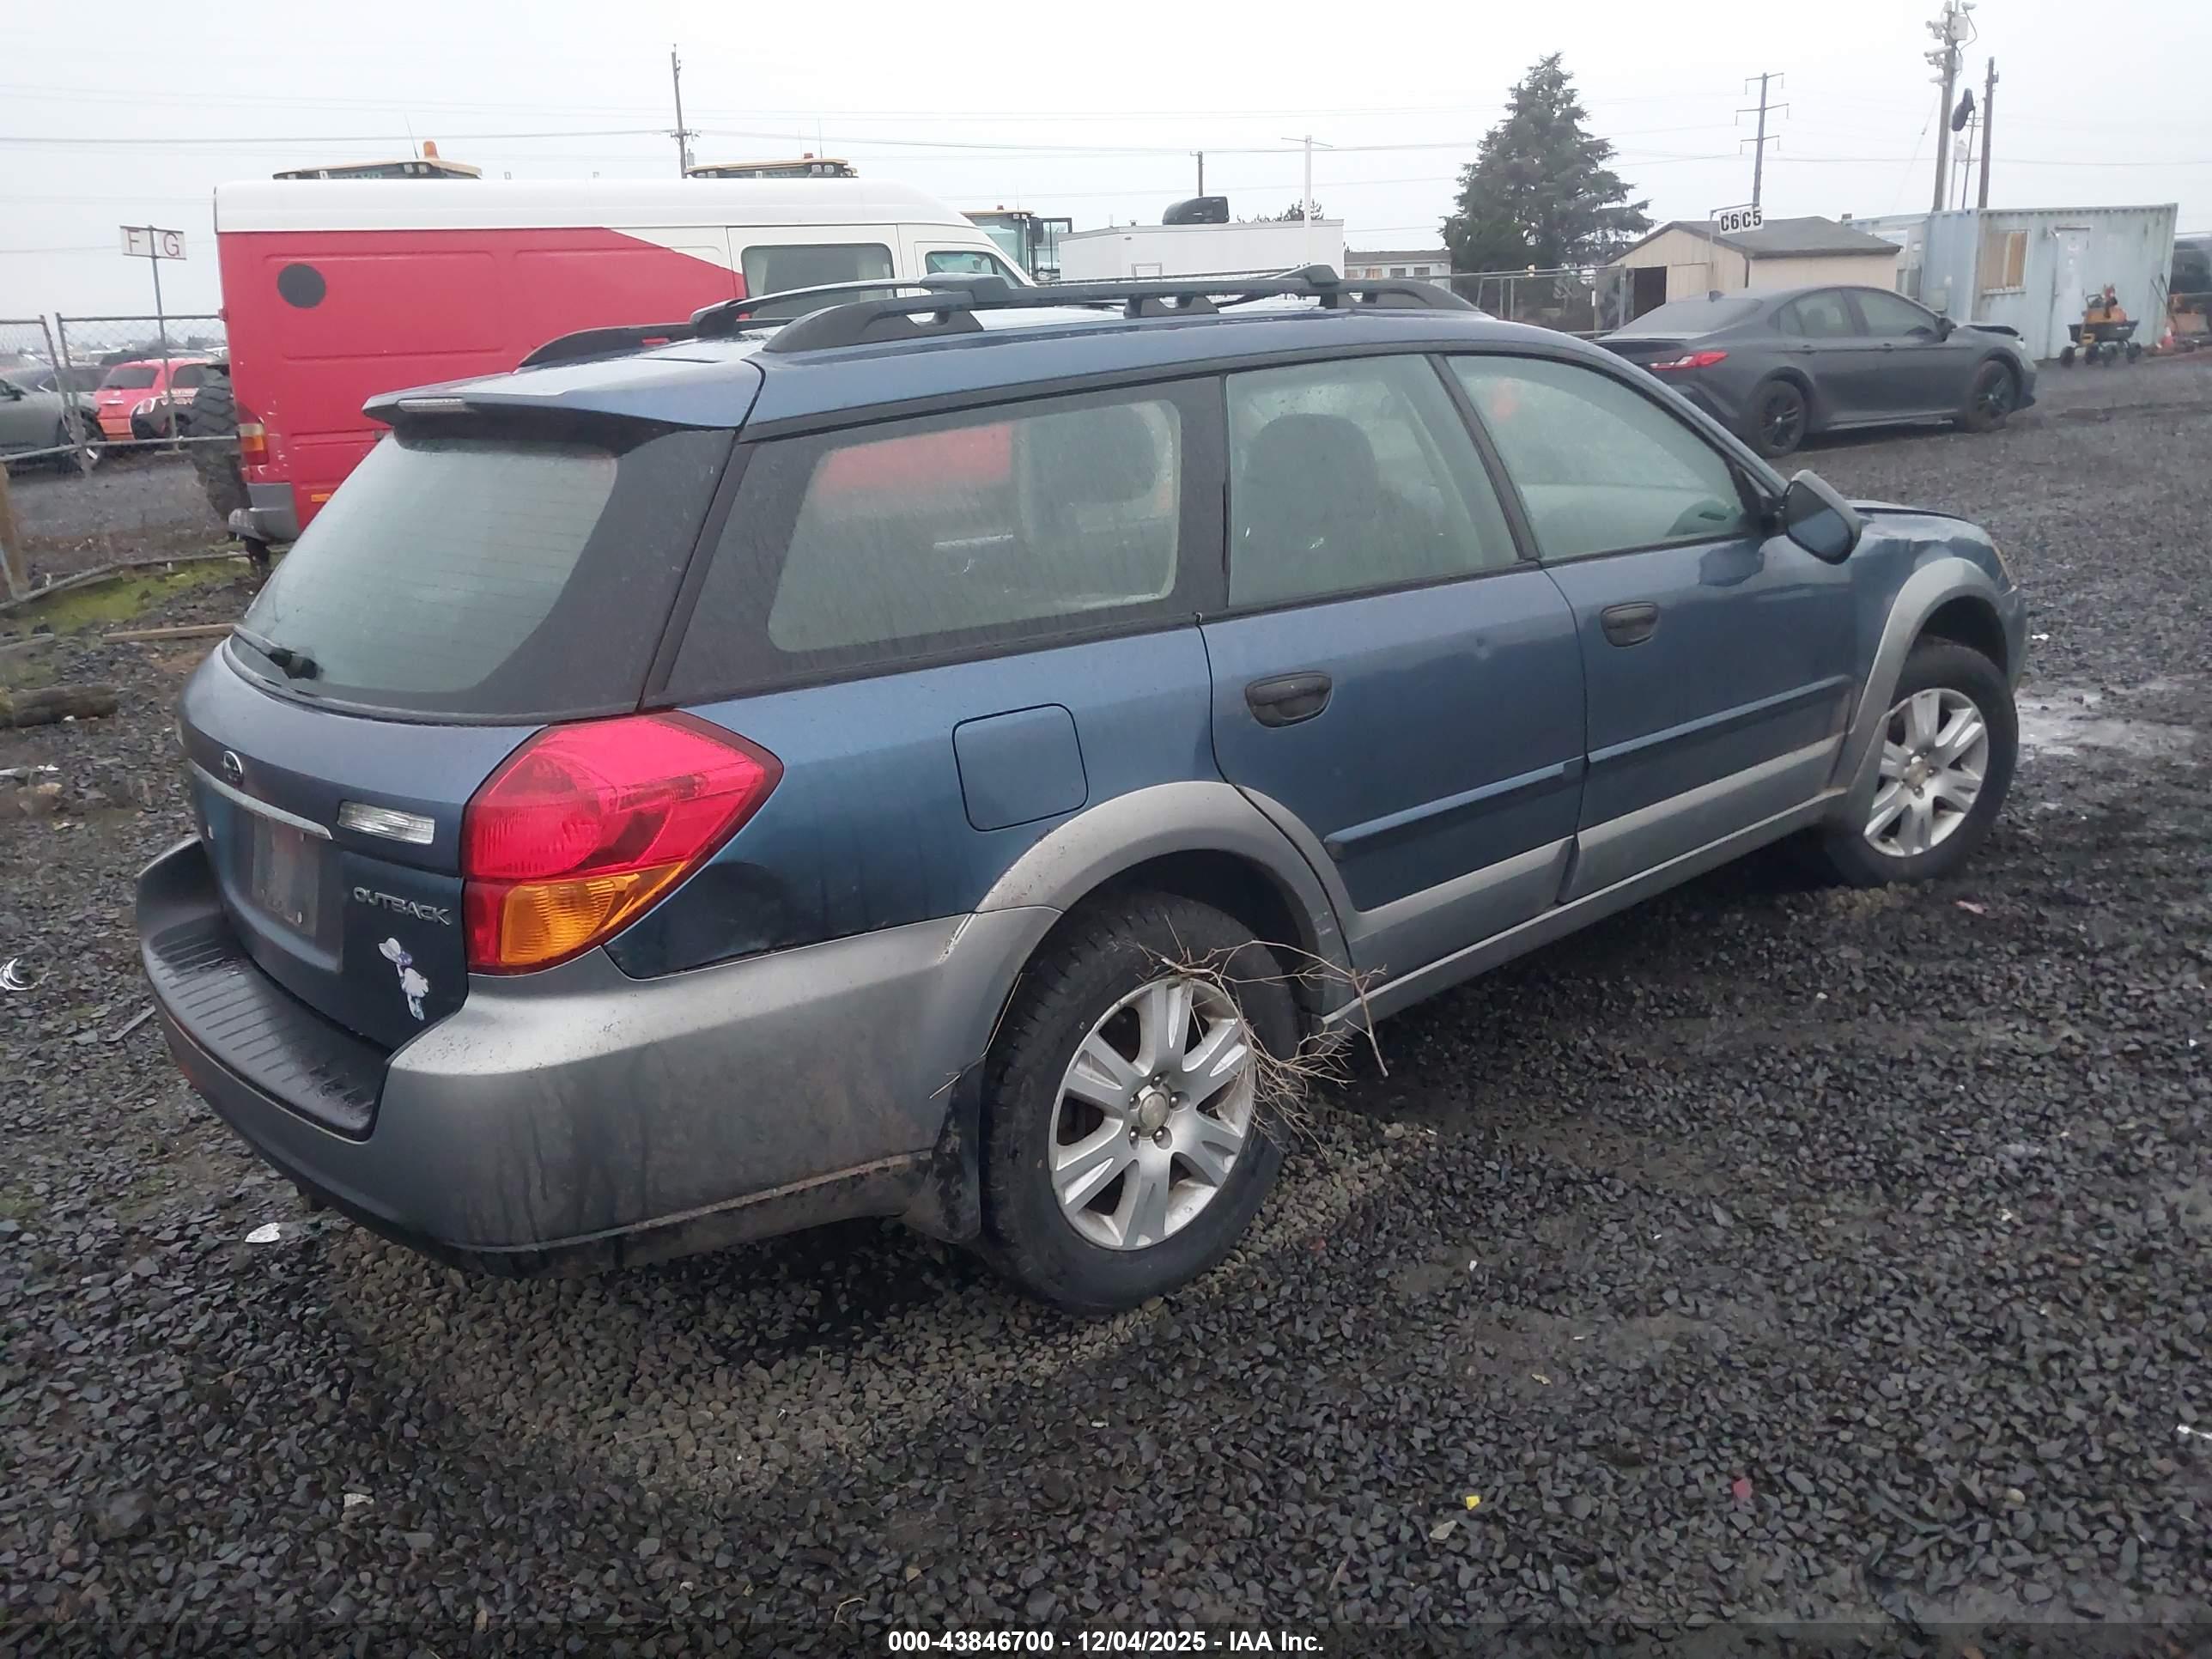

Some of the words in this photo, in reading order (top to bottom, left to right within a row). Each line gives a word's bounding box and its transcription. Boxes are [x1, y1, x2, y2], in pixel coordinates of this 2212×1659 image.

[1721, 214, 1739, 231] C6
[1742, 210, 1761, 228] C5
[126, 228, 140, 254] F
[163, 232, 180, 257] G
[353, 886, 452, 927] OUTBACK
